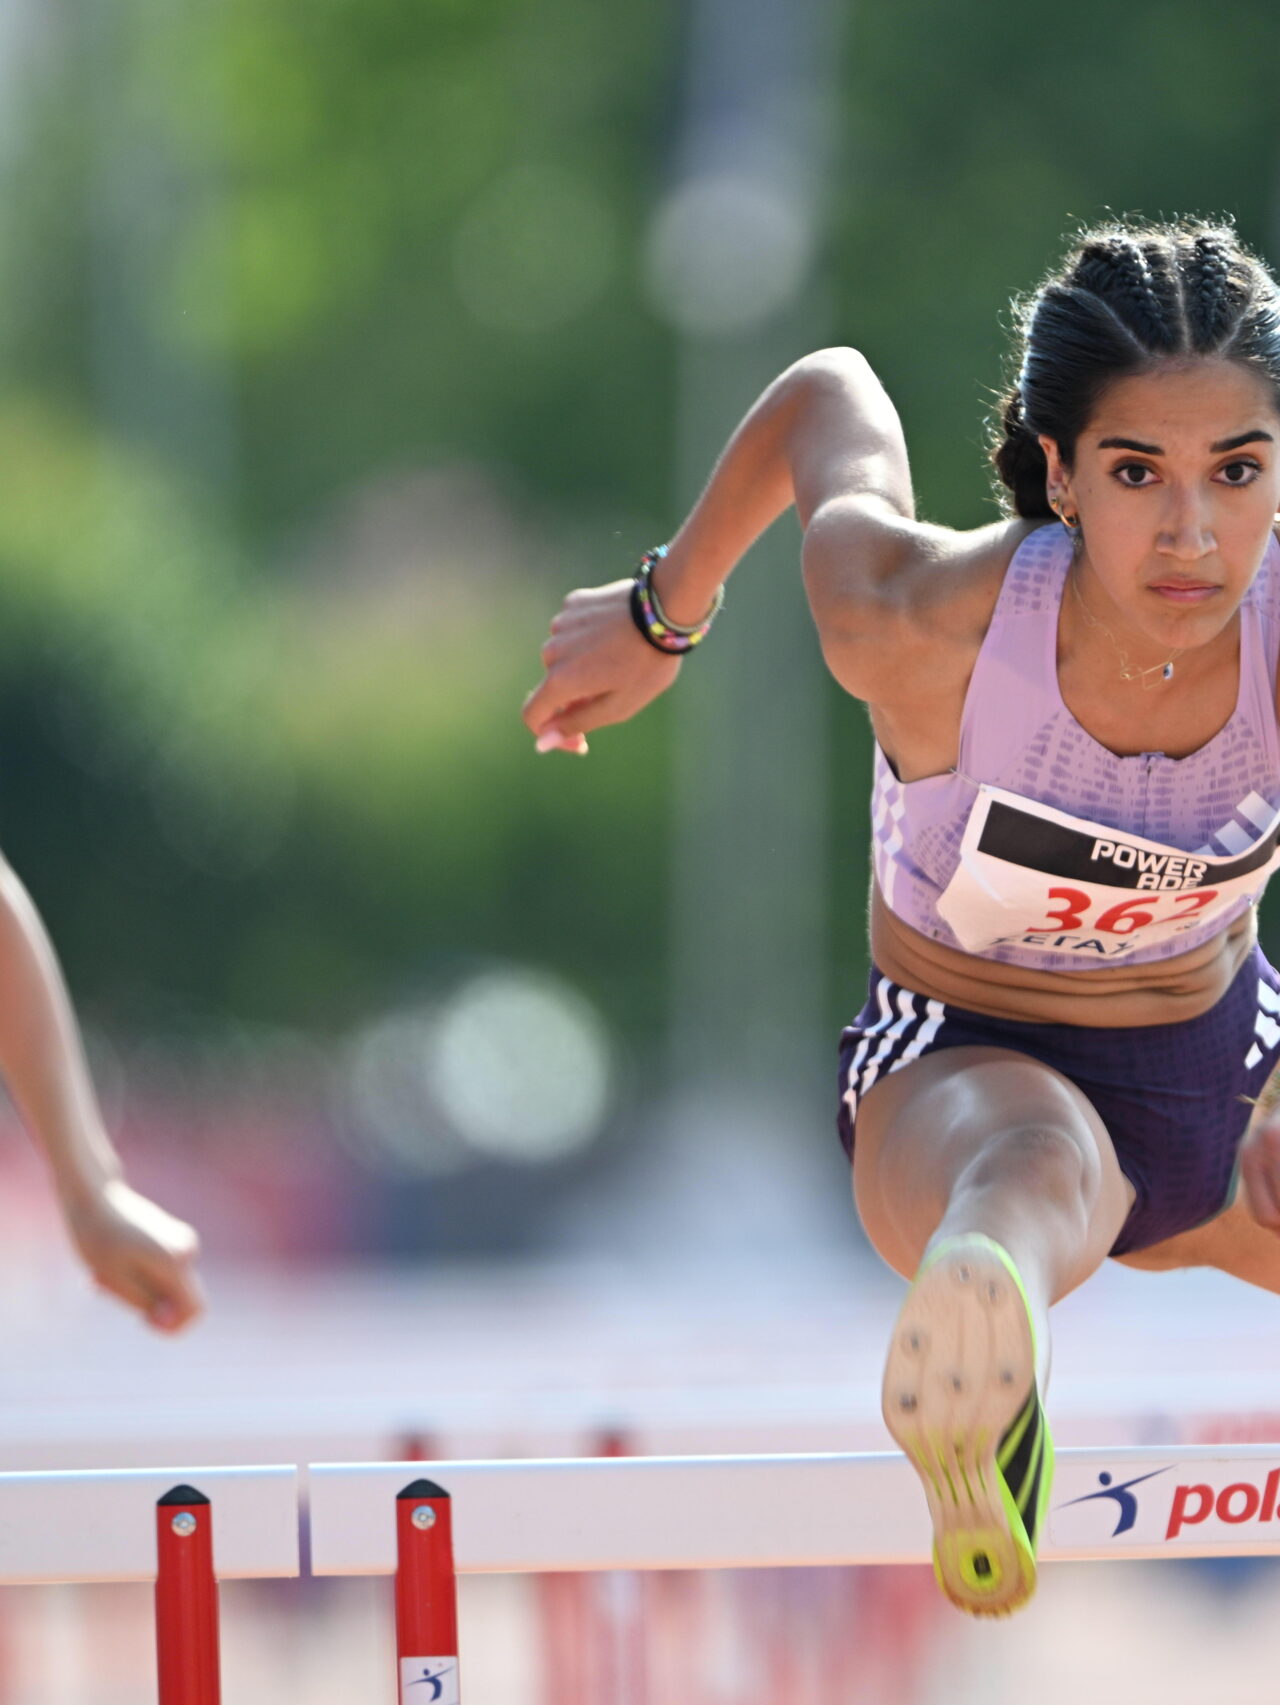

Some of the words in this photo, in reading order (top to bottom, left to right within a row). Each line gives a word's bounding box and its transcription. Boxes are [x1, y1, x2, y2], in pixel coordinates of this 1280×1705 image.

[1090, 838, 1208, 879] POWER
[1135, 872, 1203, 890] ADE
[1024, 887, 1219, 935] 362
